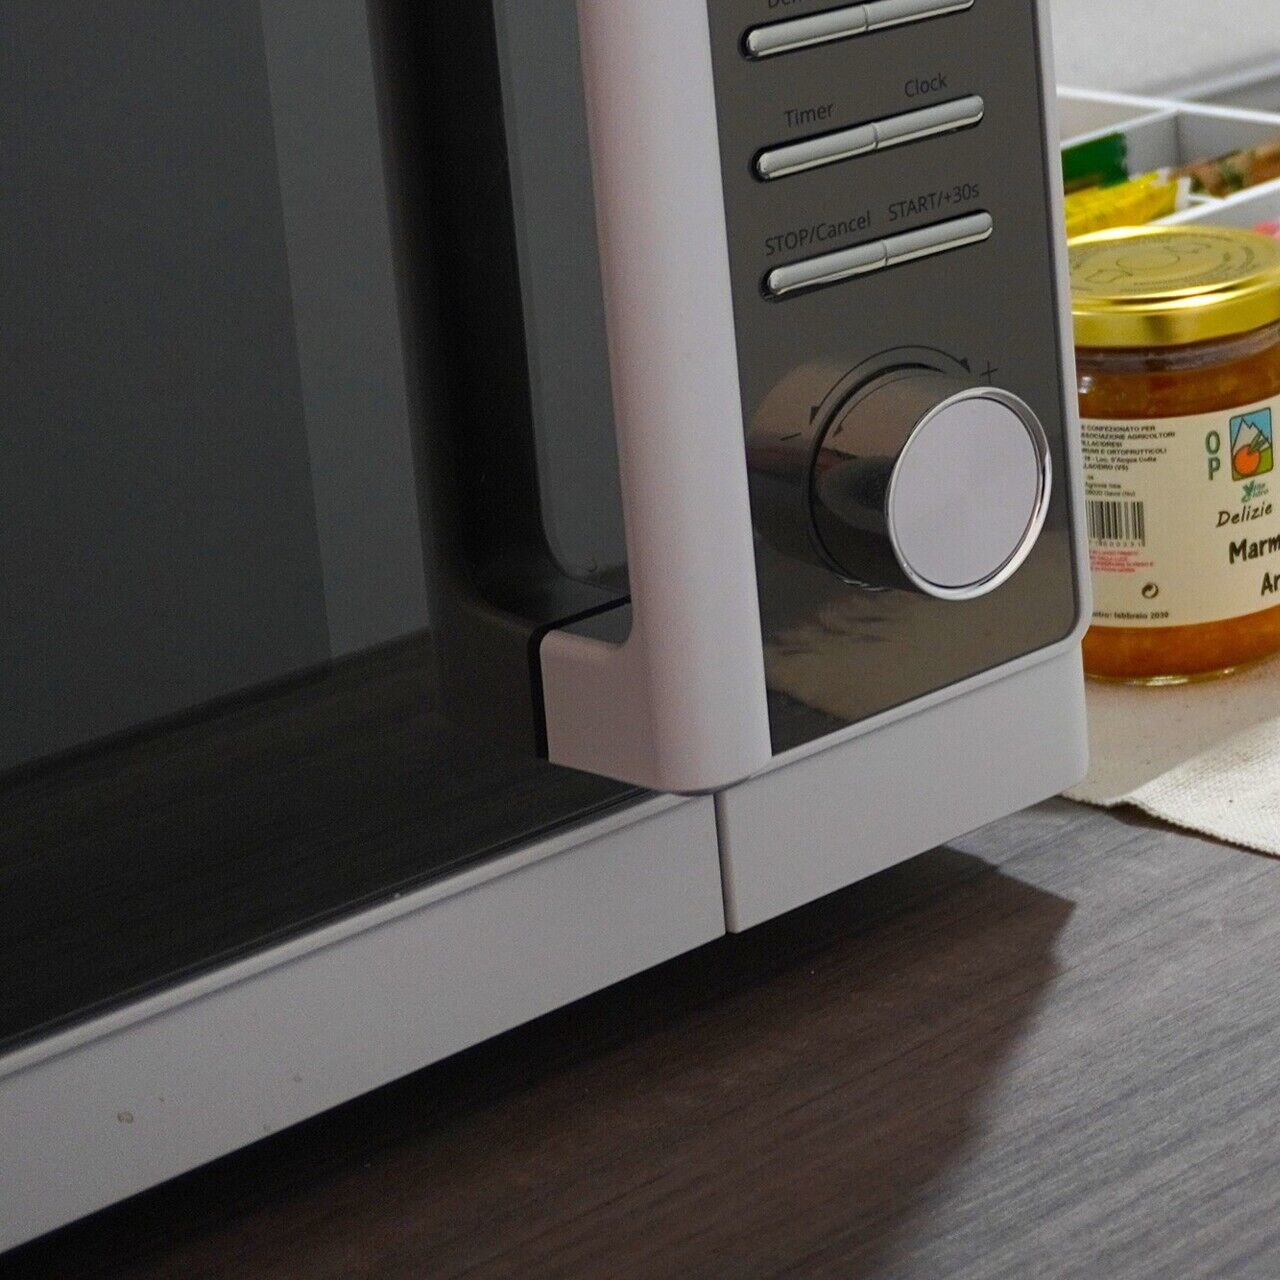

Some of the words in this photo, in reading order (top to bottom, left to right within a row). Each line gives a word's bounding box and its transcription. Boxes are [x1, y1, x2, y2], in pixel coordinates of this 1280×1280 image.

[904, 73, 948, 98] Clock
[784, 102, 835, 128] Timer
[888, 183, 980, 222] START/+30s
[764, 210, 872, 256] STOP/Cancel
[1216, 502, 1272, 528] Delizie
